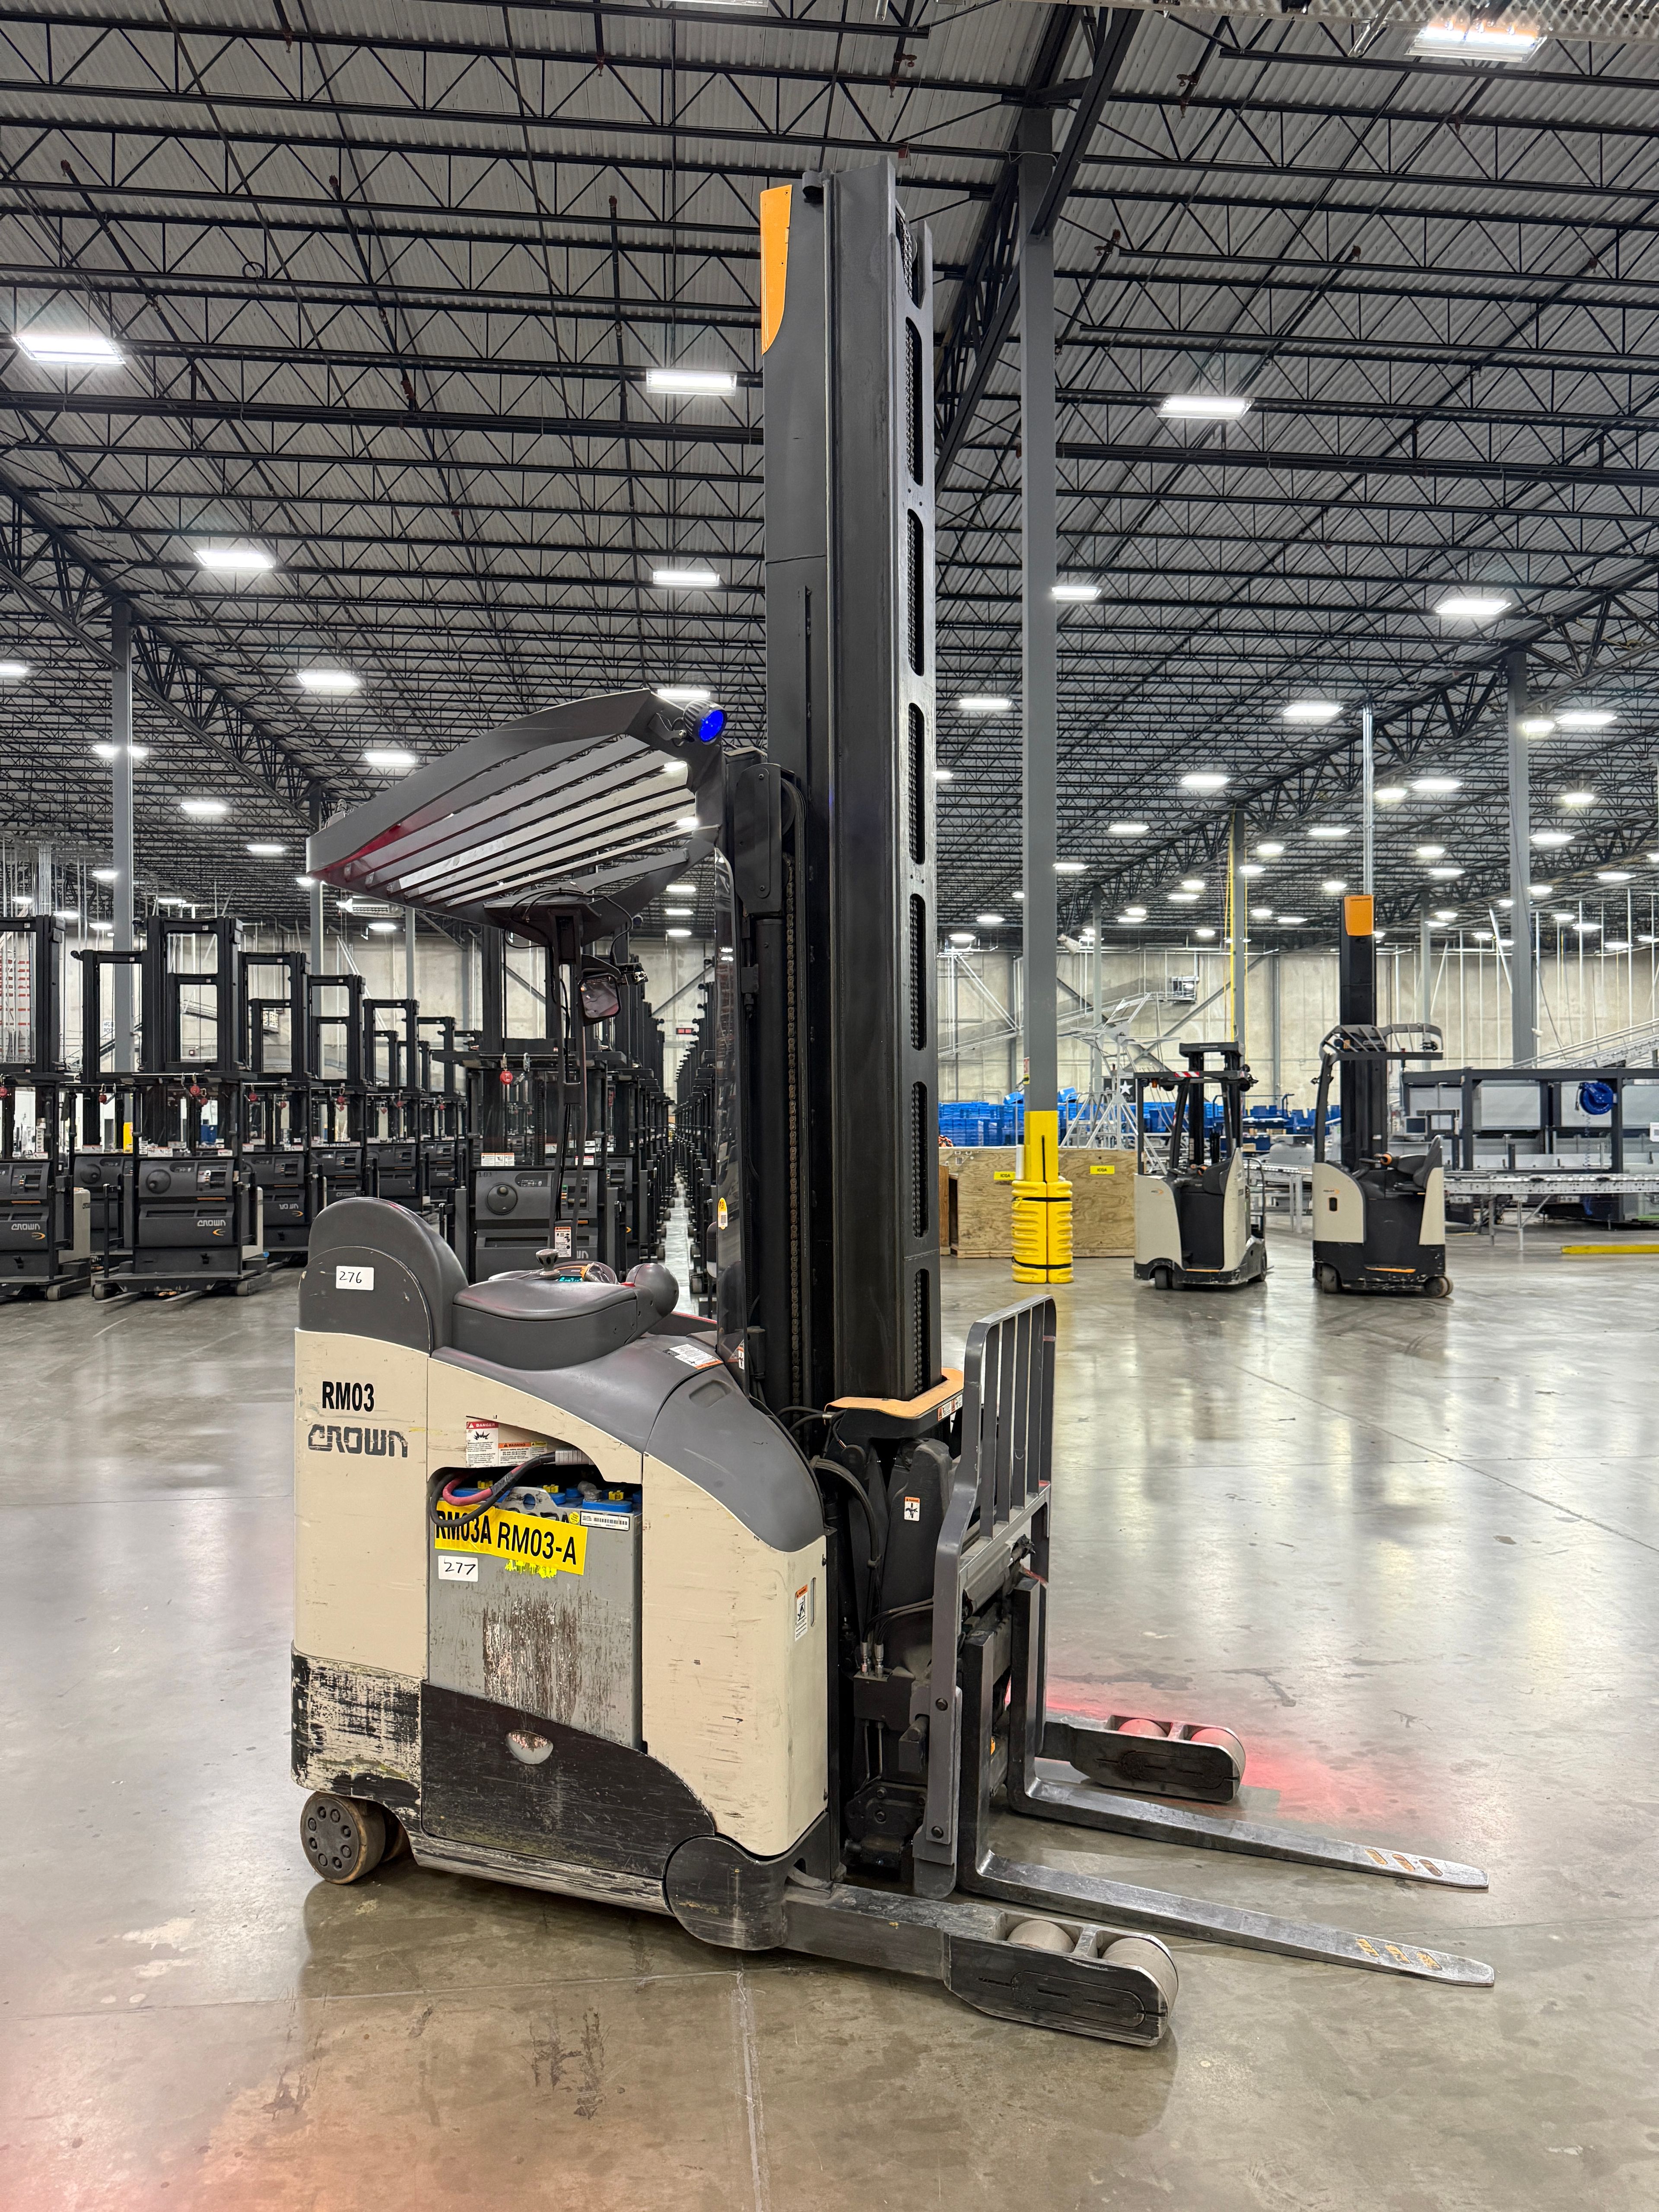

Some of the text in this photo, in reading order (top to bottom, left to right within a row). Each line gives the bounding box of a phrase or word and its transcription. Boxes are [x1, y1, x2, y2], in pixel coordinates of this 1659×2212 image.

[339, 1271, 362, 1283] 276
[322, 1381, 374, 1412] RM03
[308, 1424, 408, 1458] CROWN
[497, 1521, 576, 1565] RM03-A
[444, 1558, 476, 1575] 277
